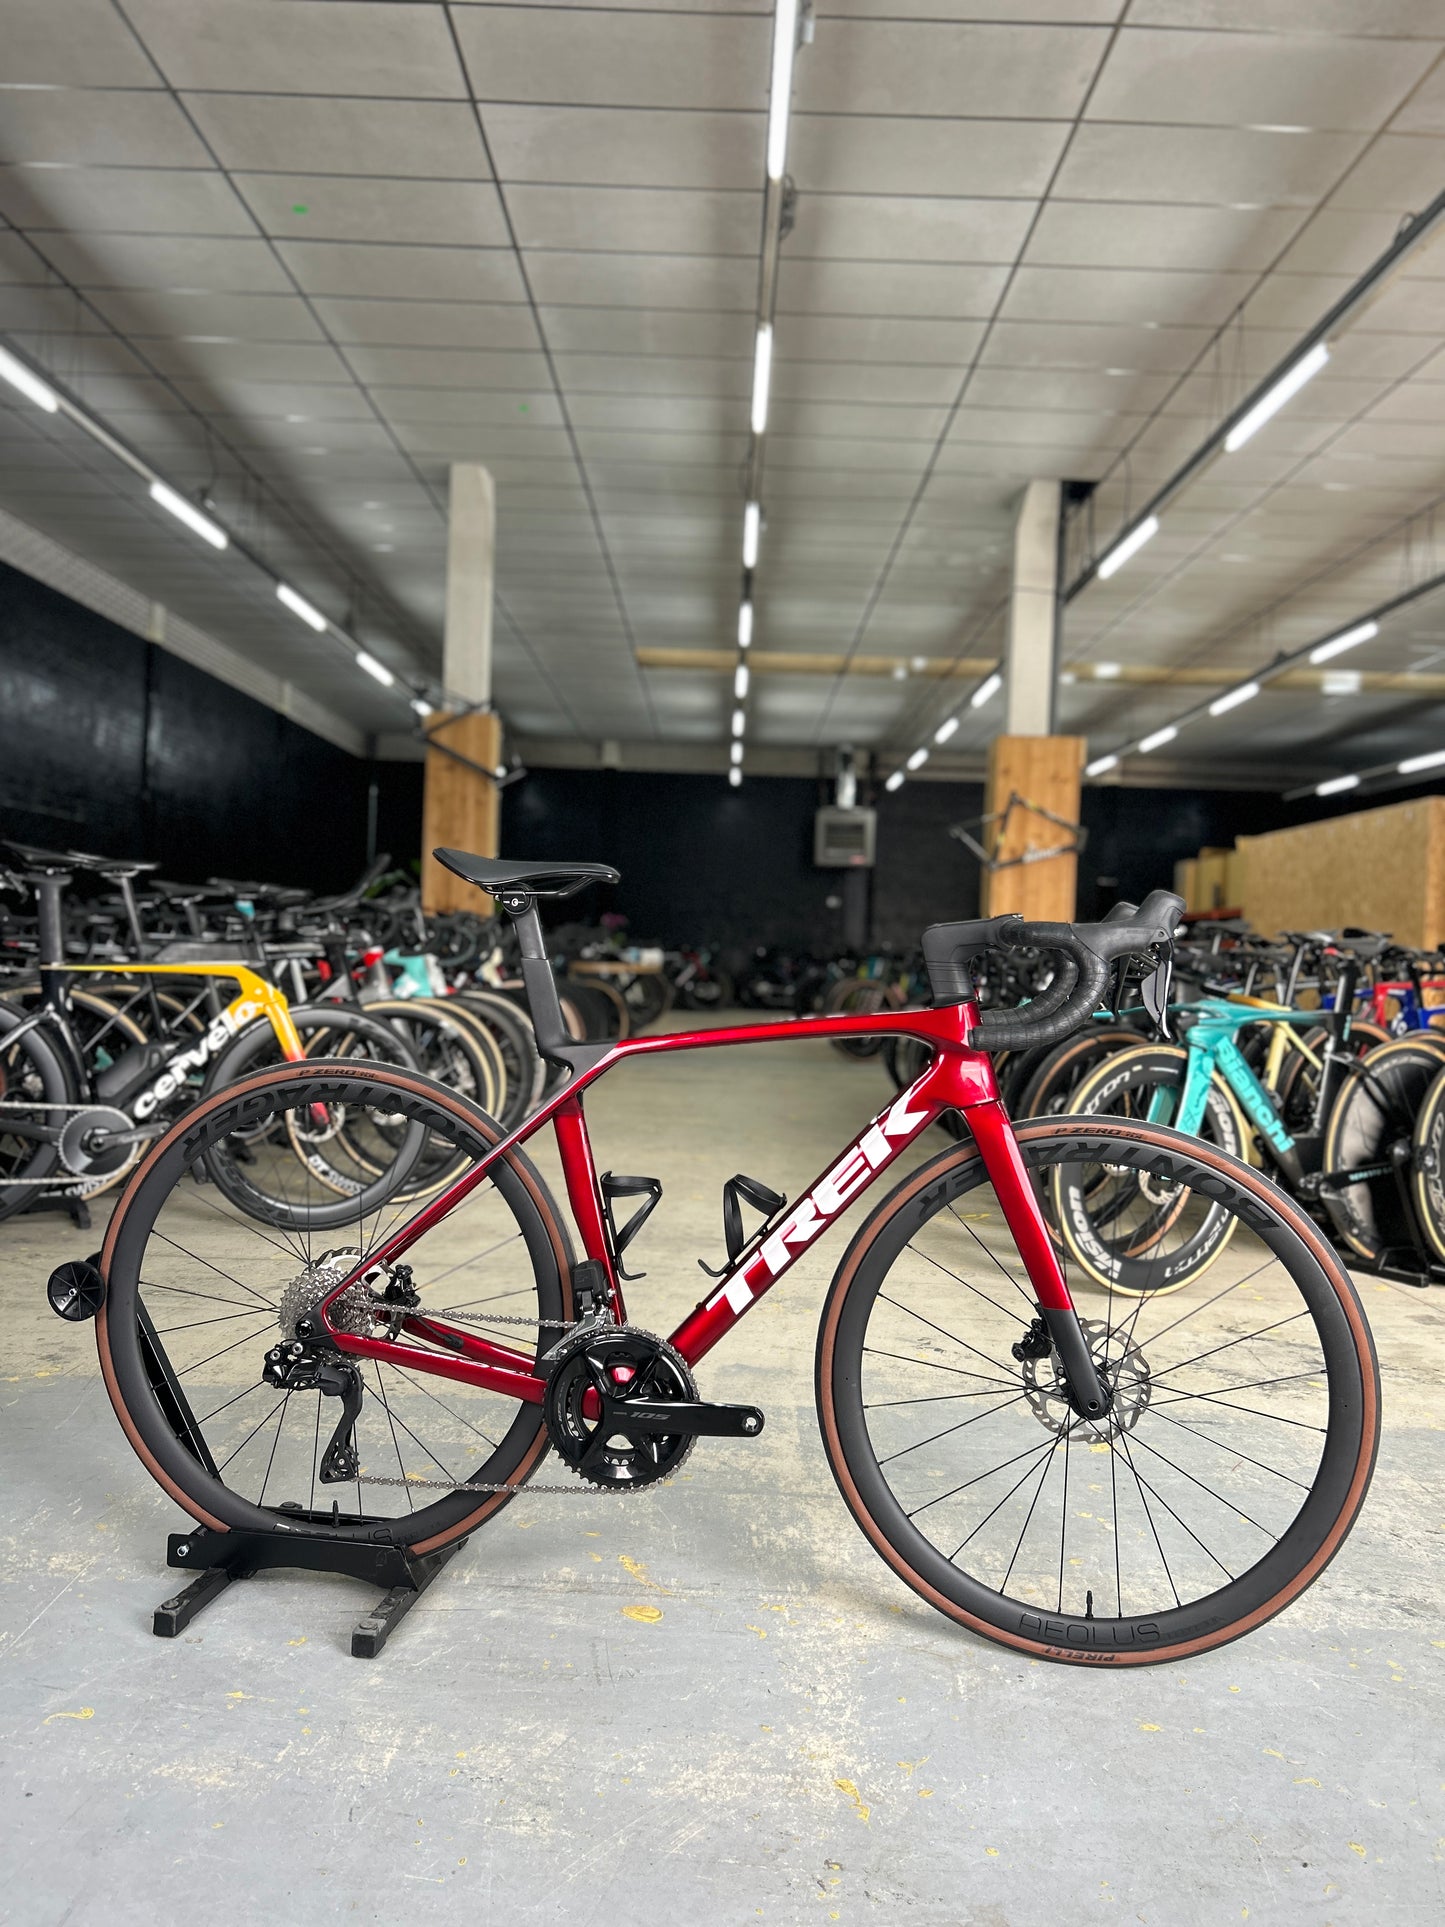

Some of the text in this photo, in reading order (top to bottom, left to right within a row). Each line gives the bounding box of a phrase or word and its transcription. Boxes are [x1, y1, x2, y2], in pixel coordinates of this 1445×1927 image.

[313, 1068, 356, 1076] ZERO
[1084, 1070, 1131, 1115] tron
[1216, 1035, 1296, 1152] Bianchi
[1070, 1127, 1121, 1136] ZERO
[706, 1086, 929, 1315] TREK
[919, 1141, 1280, 1231] BONTRAER
[630, 1411, 671, 1420] 105
[1018, 1612, 1160, 1646] AEOLUS
[1044, 1645, 1116, 1662] PIRELLI
